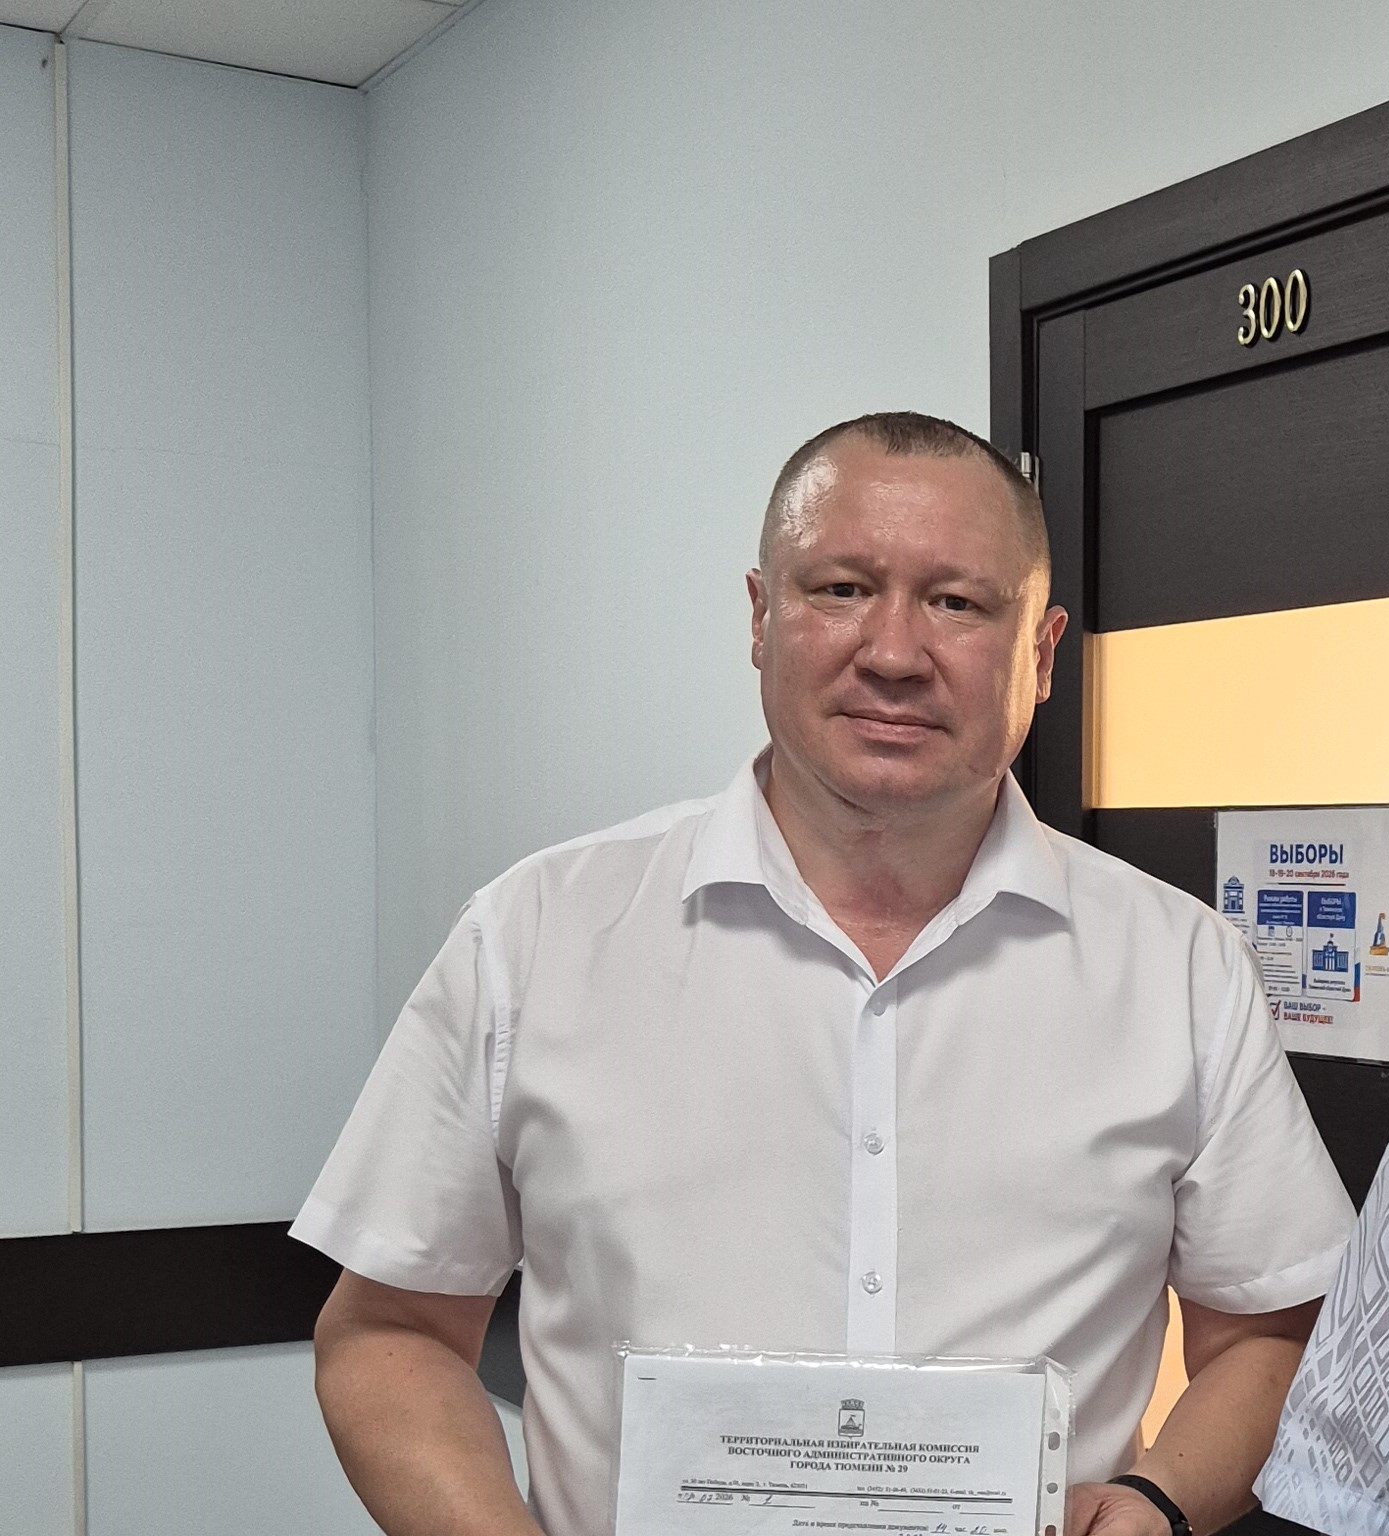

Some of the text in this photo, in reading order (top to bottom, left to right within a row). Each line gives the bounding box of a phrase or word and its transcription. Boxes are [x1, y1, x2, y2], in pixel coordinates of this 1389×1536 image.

[1238, 269, 1307, 345] 300
[1270, 844, 1344, 864] ВЫБОРЫ
[1295, 870, 1320, 879] сентября
[1321, 870, 1335, 878] 2026
[1321, 897, 1341, 905] ВЫБОРЫ
[1284, 1001, 1321, 1011] ВАШ ВЫБОР
[1284, 1012, 1301, 1021] ВАШЕ
[719, 1435, 979, 1453] ТЕРРИТОРИАЛЬНАЯ ИЗБИРАТЕЛЬНАЯ КОМИССИЯ
[728, 1446, 970, 1464] ВОСТОЧНОГО АДМИНИСТРАТИВНОГО ОКРУГА
[790, 1460, 831, 1471] ГОРОДА
[835, 1462, 883, 1473] ТЮМЕНИ
[885, 1464, 896, 1472] №
[792, 1518, 809, 1527] Дата
